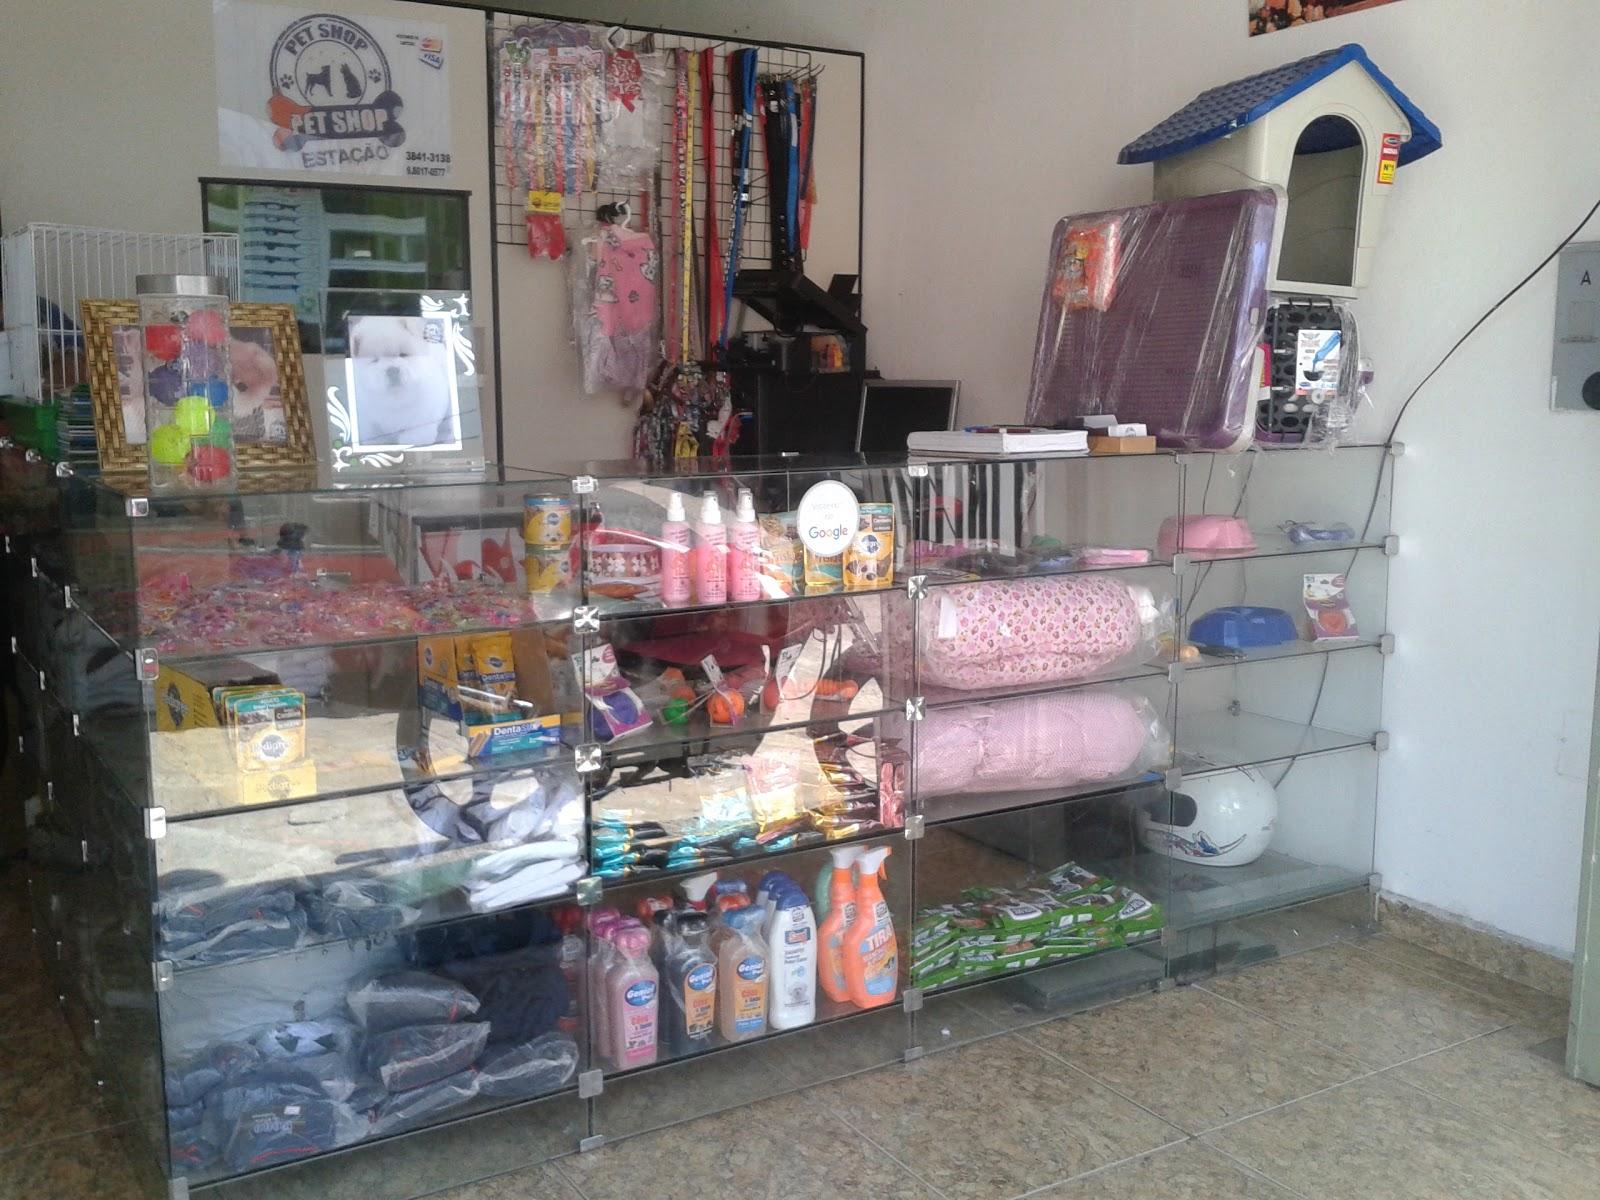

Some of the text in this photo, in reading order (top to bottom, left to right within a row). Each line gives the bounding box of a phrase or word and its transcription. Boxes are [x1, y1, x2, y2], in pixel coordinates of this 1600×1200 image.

[284, 27, 315, 56] PET
[318, 23, 369, 51] SHOP
[291, 108, 388, 135] PET SHOP
[302, 144, 390, 169] ESTAÇÃO
[1580, 269, 1591, 286] A
[808, 523, 849, 541] Google
[865, 925, 892, 951] TIRA
